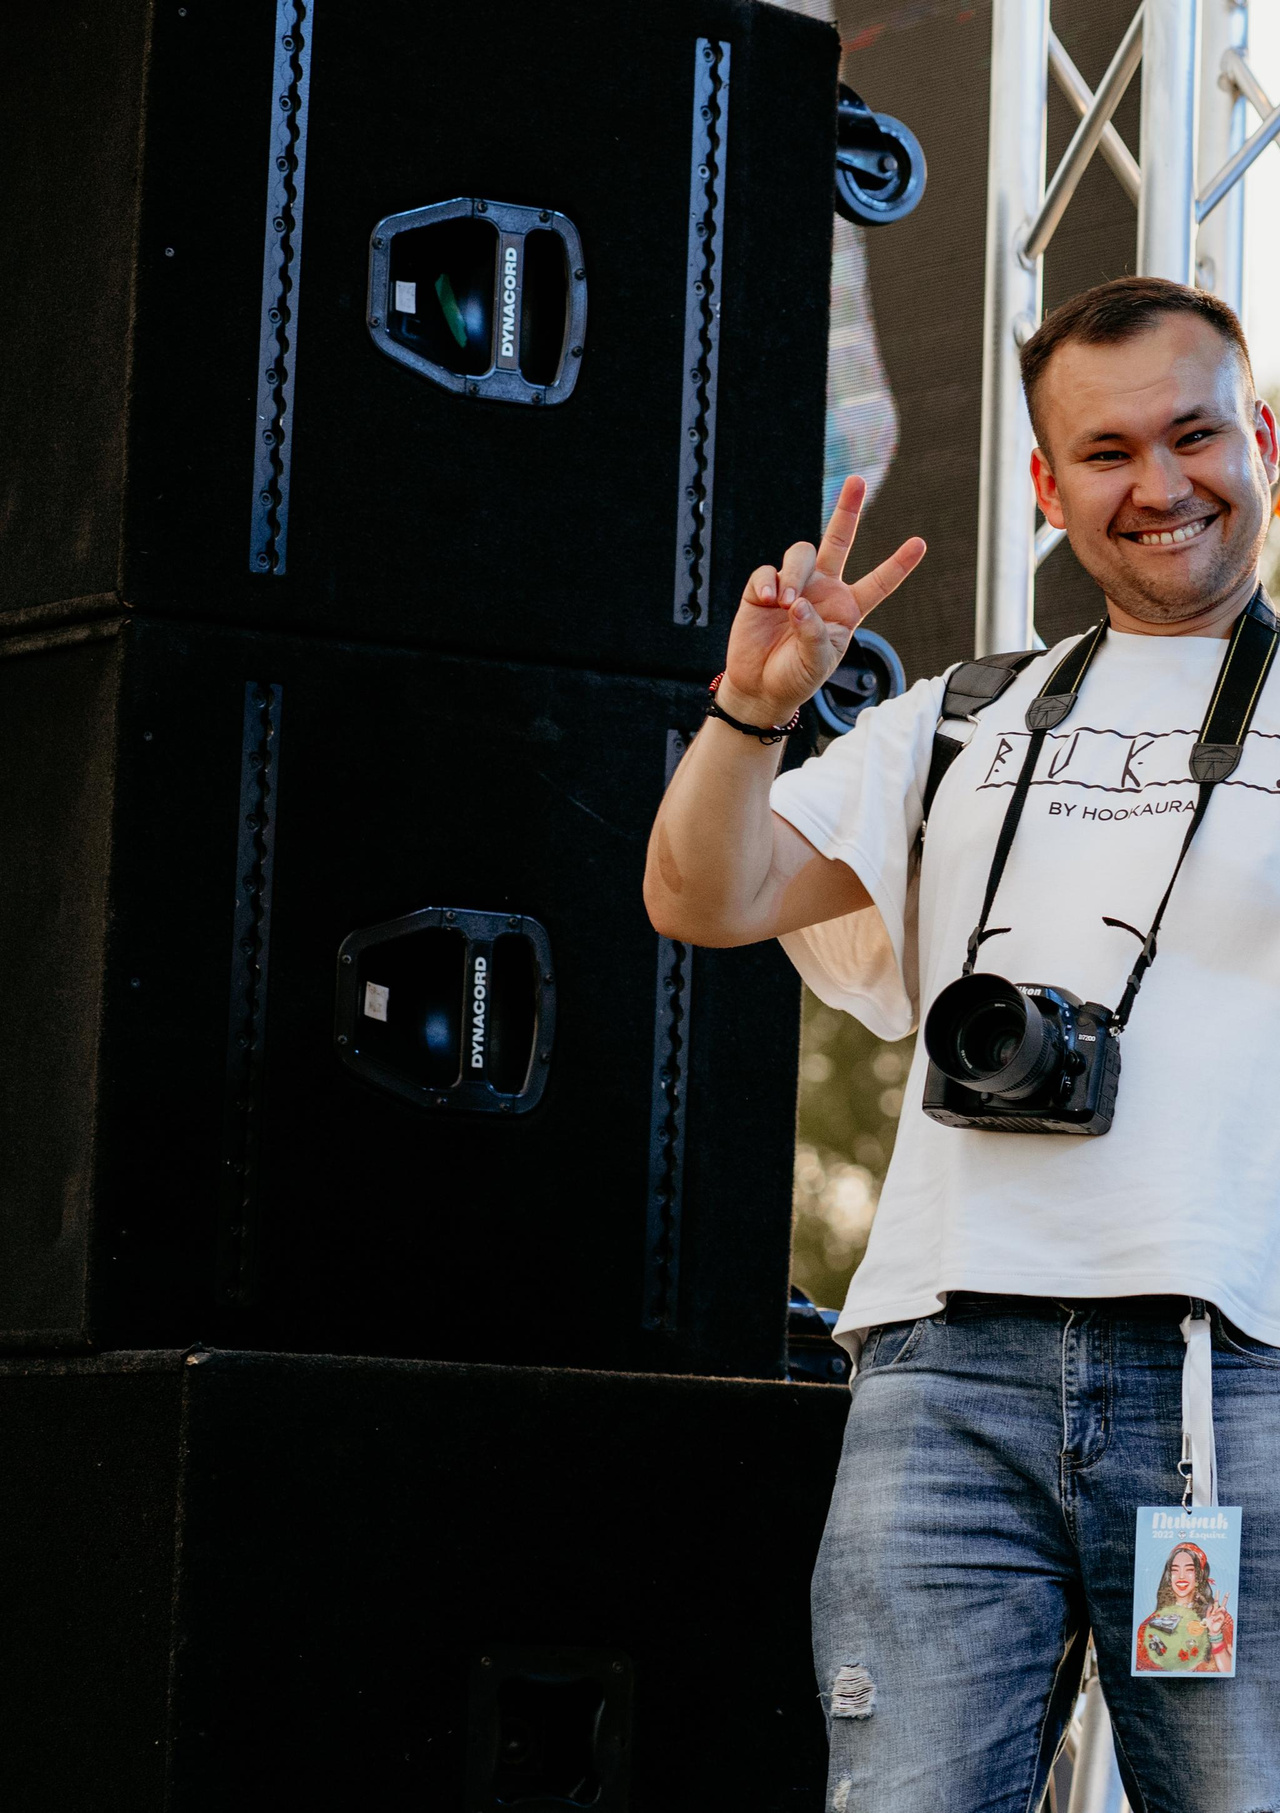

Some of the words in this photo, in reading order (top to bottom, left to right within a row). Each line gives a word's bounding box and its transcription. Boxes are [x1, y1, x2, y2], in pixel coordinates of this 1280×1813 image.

[502, 247, 517, 358] DYNACORD
[1049, 802, 1077, 817] BY
[1082, 799, 1197, 822] HOOKAURA
[471, 956, 487, 1069] DYNACORD
[1152, 1530, 1174, 1539] 2022
